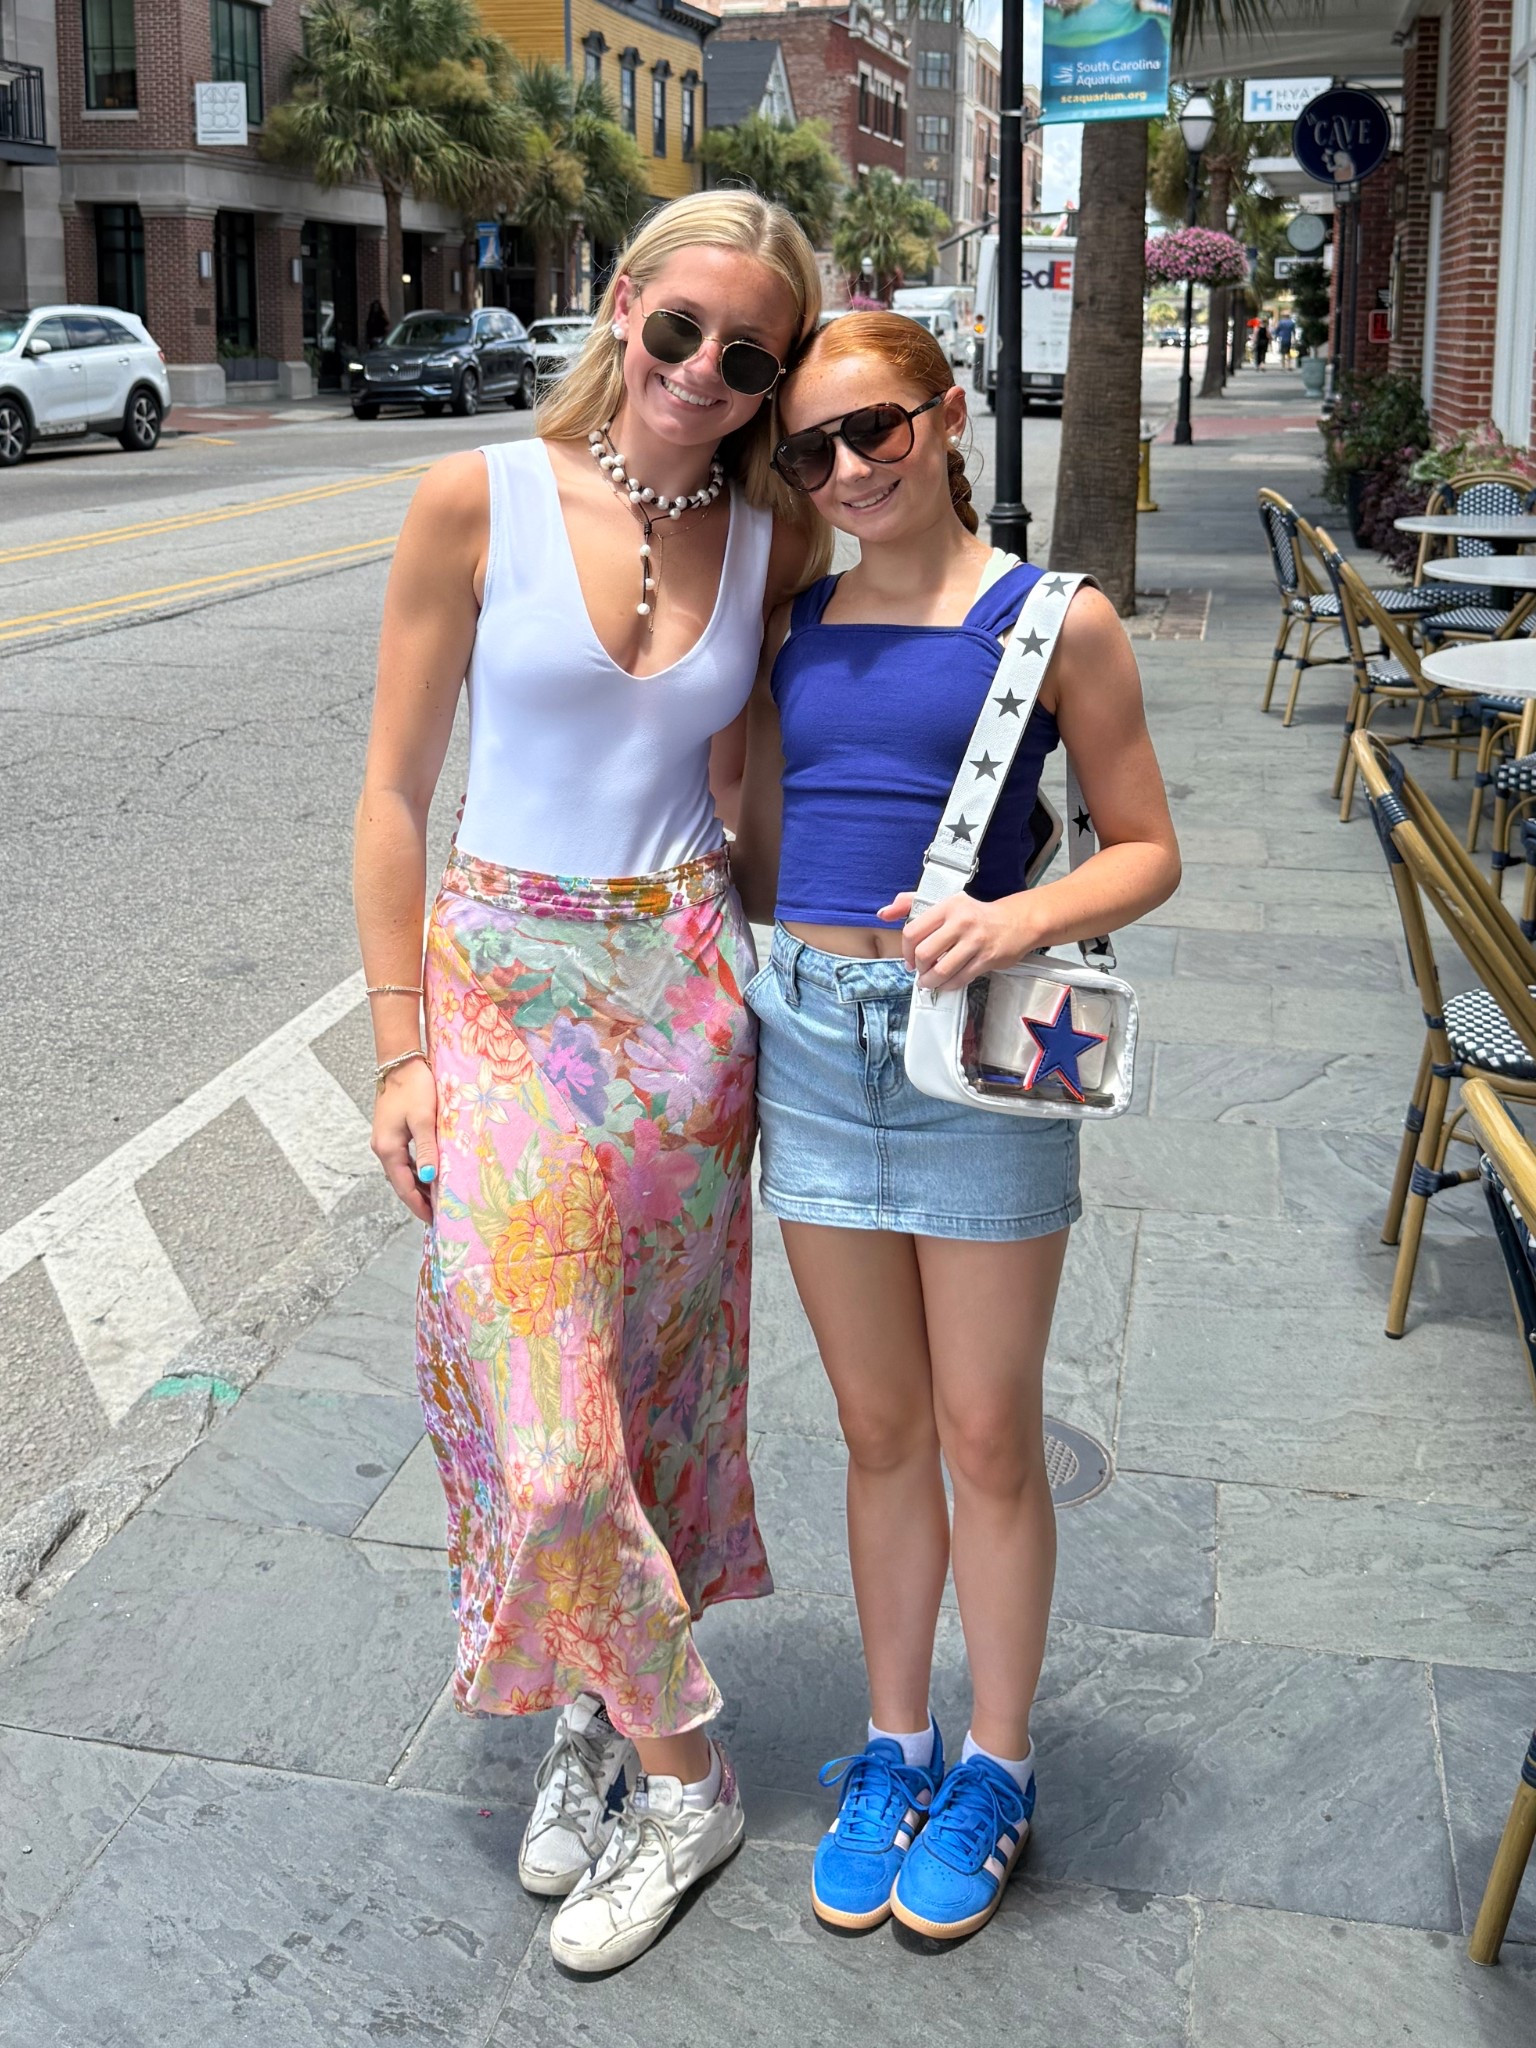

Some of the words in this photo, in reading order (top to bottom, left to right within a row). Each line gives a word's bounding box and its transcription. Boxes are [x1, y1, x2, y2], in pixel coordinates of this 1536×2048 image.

[1076, 61, 1110, 73] South
[1112, 59, 1161, 72] Carolina
[1076, 73, 1131, 87] Aquarium
[1060, 91, 1147, 104] scaquarium.org
[1276, 87, 1328, 100] HYAT
[1314, 114, 1371, 150] CAVE
[1022, 261, 1072, 290] edE
